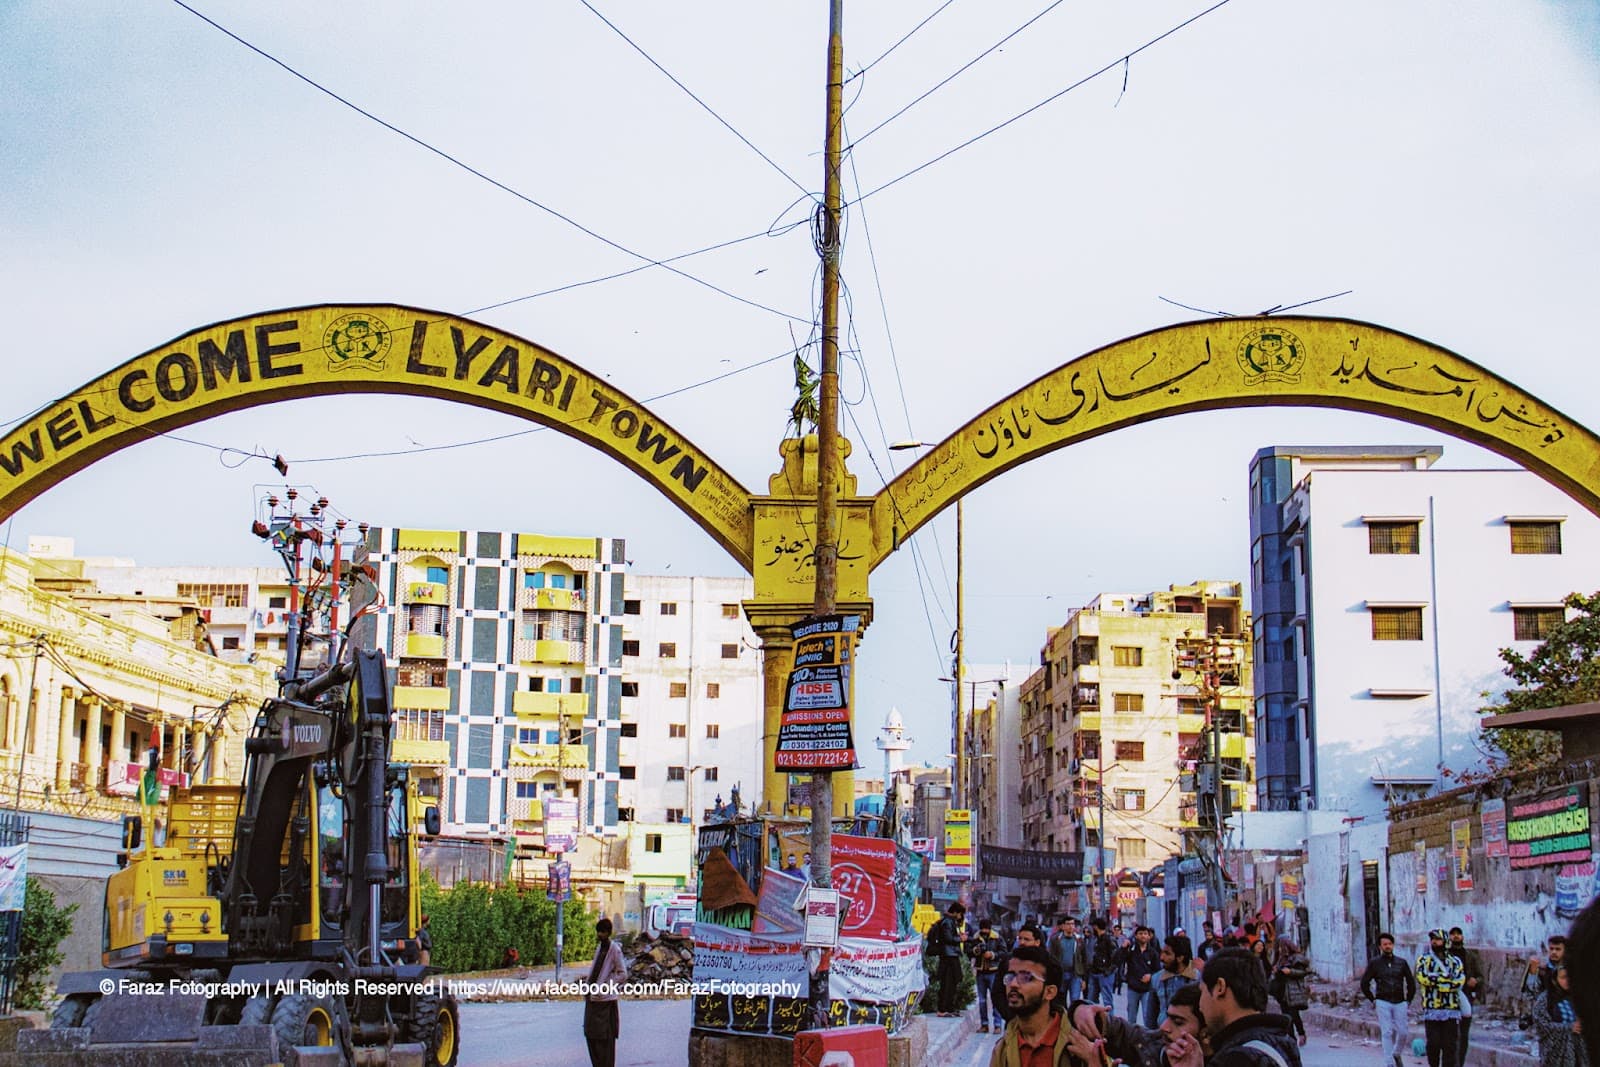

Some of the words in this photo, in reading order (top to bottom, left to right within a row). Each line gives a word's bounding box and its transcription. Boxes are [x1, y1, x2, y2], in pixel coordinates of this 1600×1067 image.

[0, 320, 303, 477] WELCOME
[406, 319, 579, 412] LYARI
[588, 388, 709, 493] TOWN
[294, 725, 322, 743] VOLVO
[840, 871, 863, 894] 27
